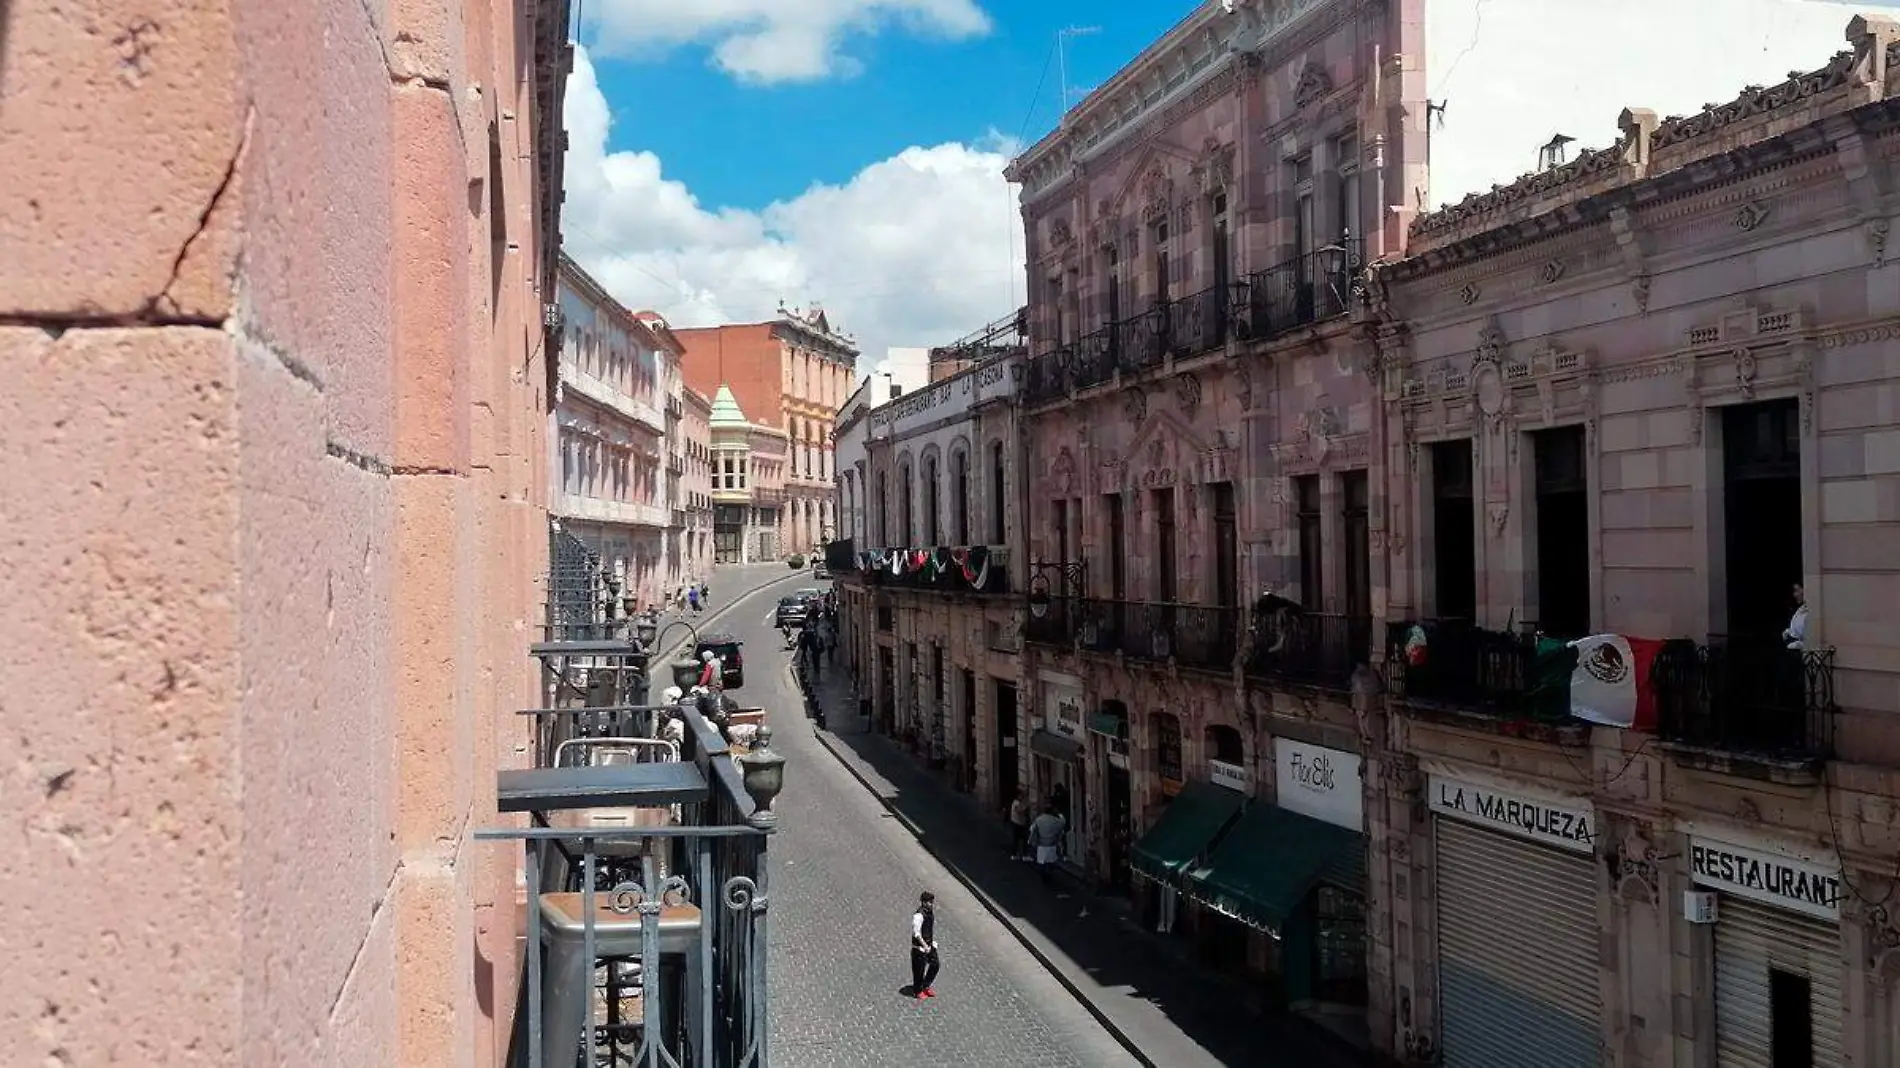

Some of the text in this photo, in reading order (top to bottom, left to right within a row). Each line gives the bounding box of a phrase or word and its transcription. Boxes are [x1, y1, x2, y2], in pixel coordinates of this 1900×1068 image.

[1441, 783, 1592, 844] LA MARQUEZA
[1691, 845, 1840, 909] RESTAURANT
